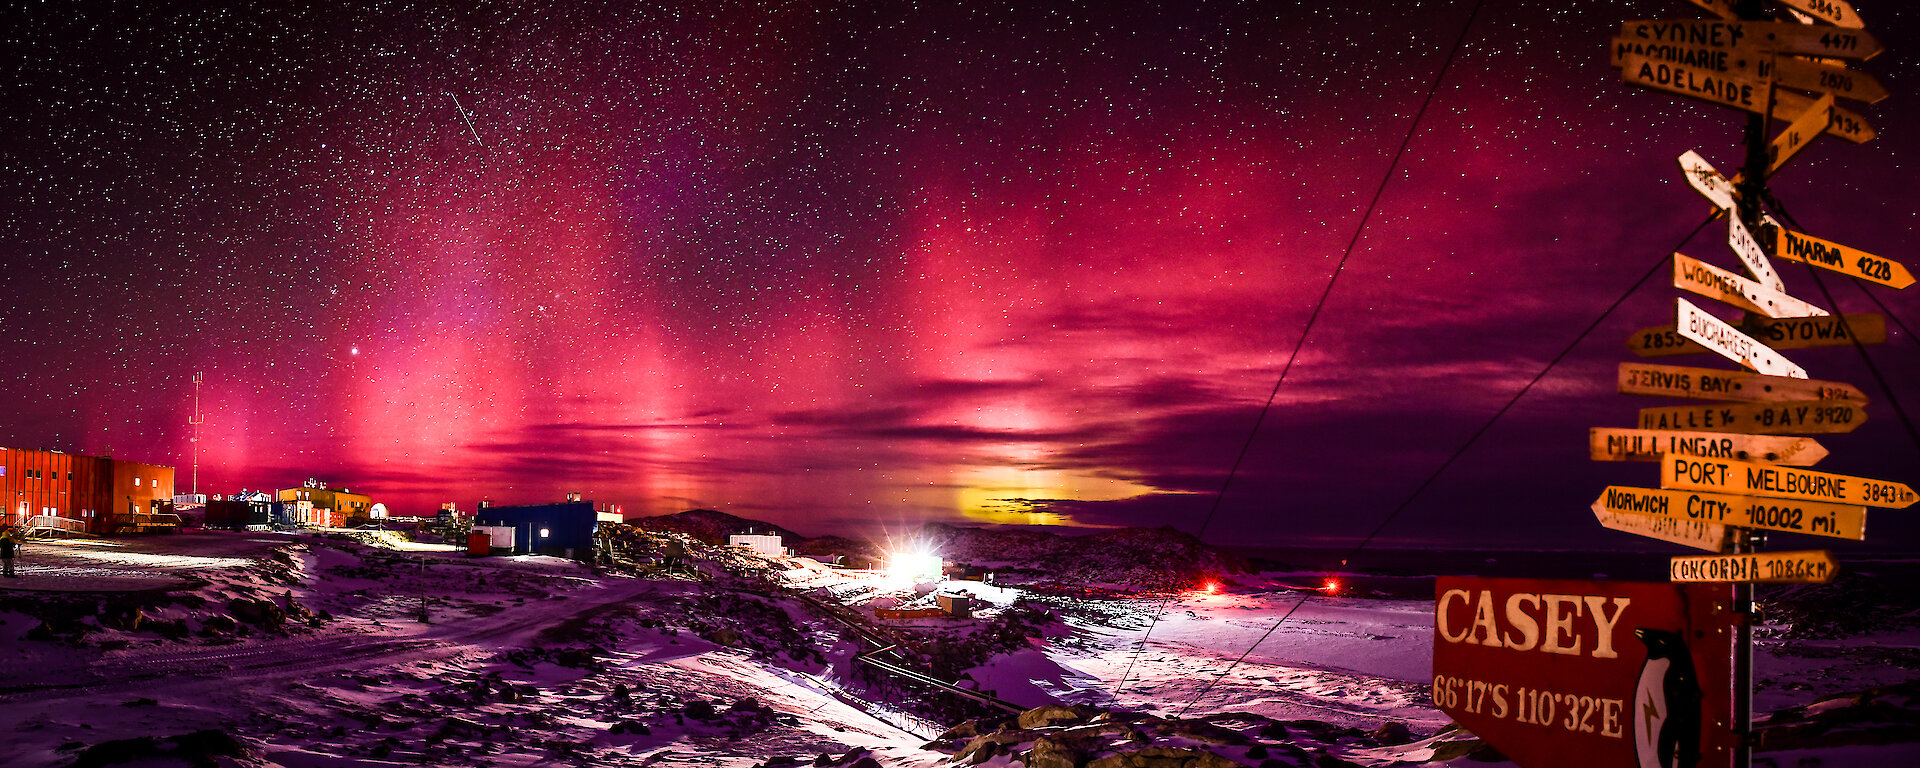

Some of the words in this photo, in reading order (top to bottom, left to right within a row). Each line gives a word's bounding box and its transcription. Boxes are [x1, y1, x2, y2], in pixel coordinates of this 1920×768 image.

[1636, 23, 1742, 47] SYDNEY
[1820, 32, 1857, 51] 4471
[1639, 62, 1752, 105] ADELAIDE
[1785, 231, 1844, 268] THARWA
[1857, 256, 1891, 281] 4228
[1682, 261, 1746, 297] WOOMERA
[1690, 311, 1752, 361] BUCHAREST
[1770, 320, 1847, 341] SYOWA
[1627, 369, 1691, 391] JERVIS
[1701, 375, 1731, 392] BAY
[1763, 407, 1808, 427] BAY
[1814, 407, 1852, 424] 3920
[1675, 459, 1728, 486] PORT
[1748, 467, 1846, 499] MELBOURNE
[1863, 482, 1896, 503] 3843
[1672, 557, 1759, 580] CONCORDIA
[1437, 588, 1631, 658] CASEY
